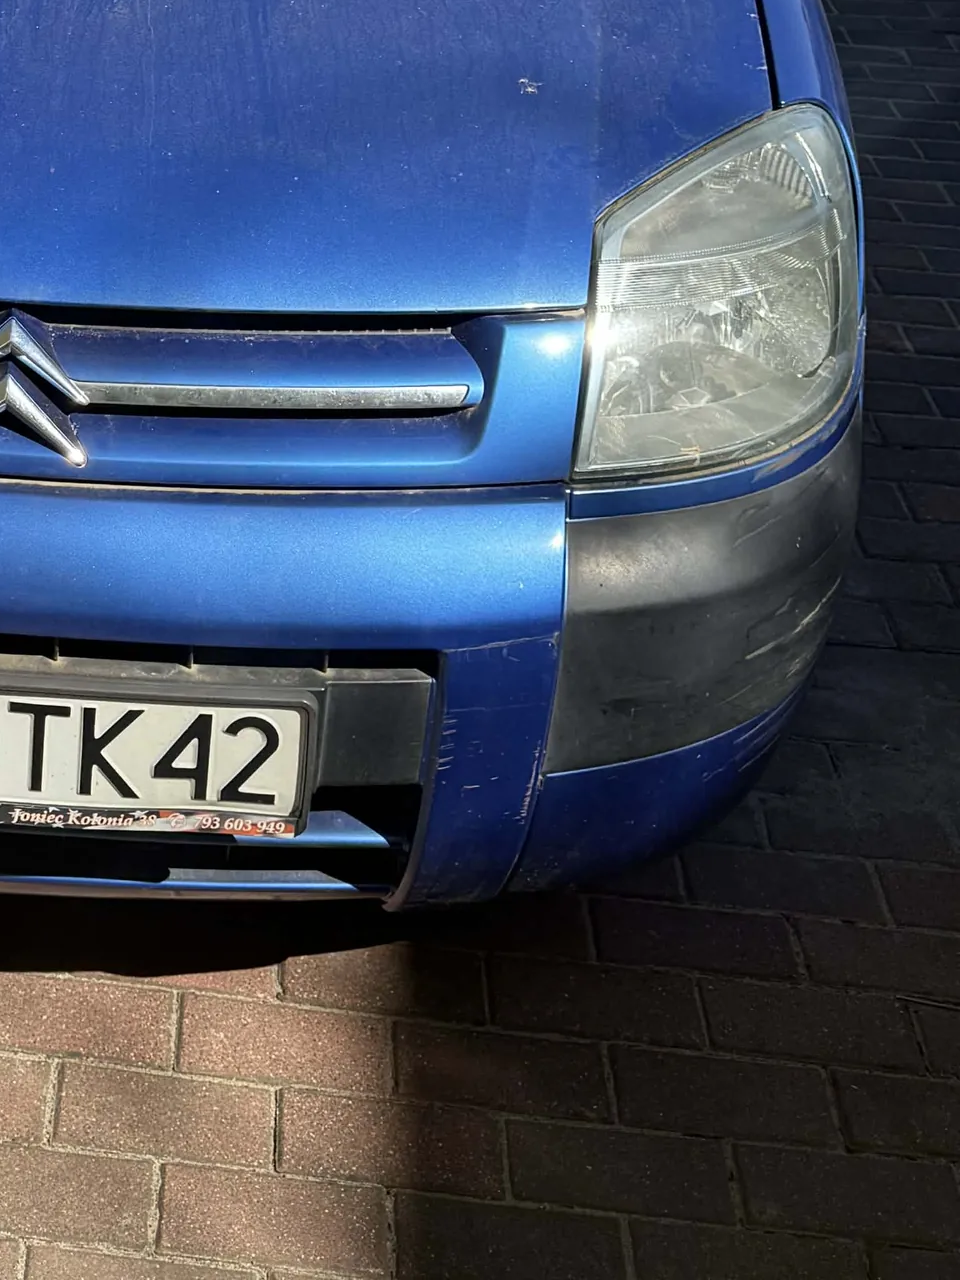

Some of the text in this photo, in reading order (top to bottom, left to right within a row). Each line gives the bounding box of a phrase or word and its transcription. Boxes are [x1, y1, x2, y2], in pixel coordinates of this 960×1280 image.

[8, 699, 280, 805] TK42
[10, 808, 64, 825] Joniec
[193, 814, 220, 830] 793
[223, 816, 253, 832] 603
[255, 820, 285, 834] 949
